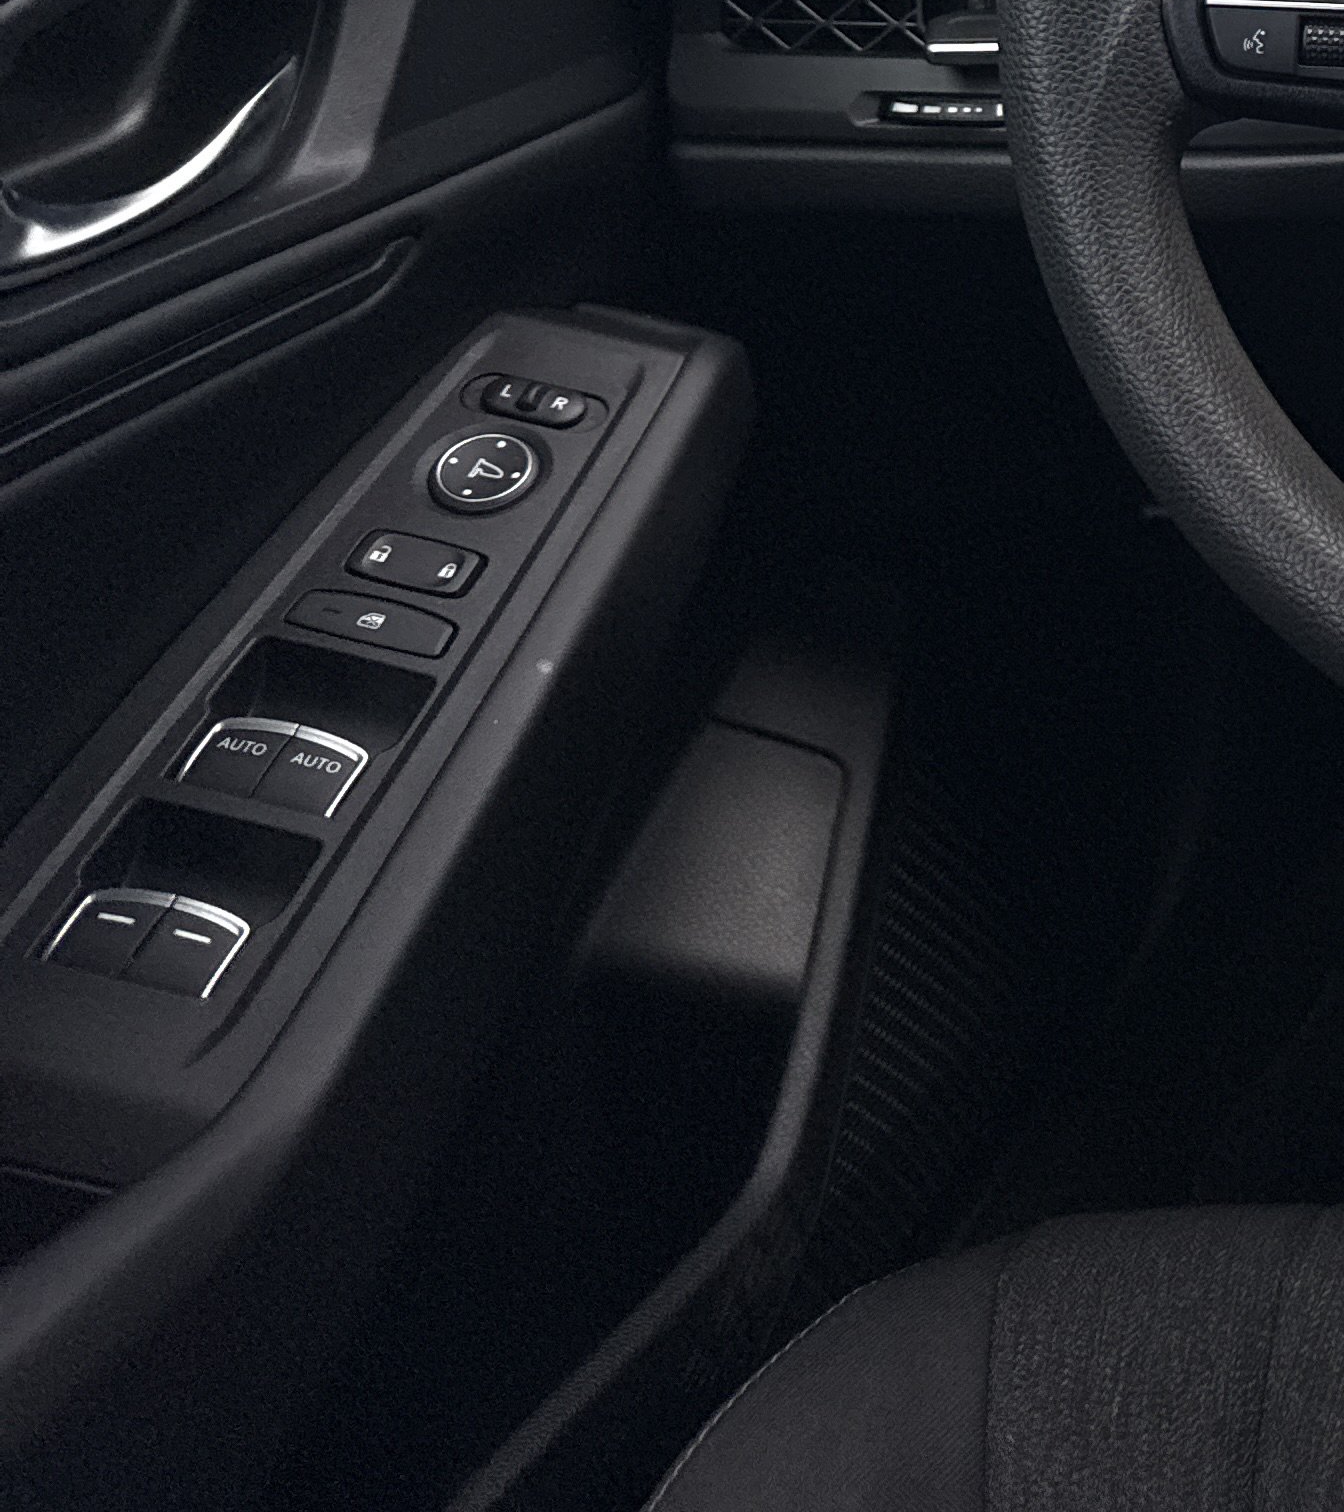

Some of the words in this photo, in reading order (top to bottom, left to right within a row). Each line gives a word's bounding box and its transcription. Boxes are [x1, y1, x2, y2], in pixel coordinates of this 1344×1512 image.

[500, 384, 511, 398] L
[550, 396, 569, 410] R
[216, 735, 268, 757] AUTO
[290, 751, 342, 774] AUTO
